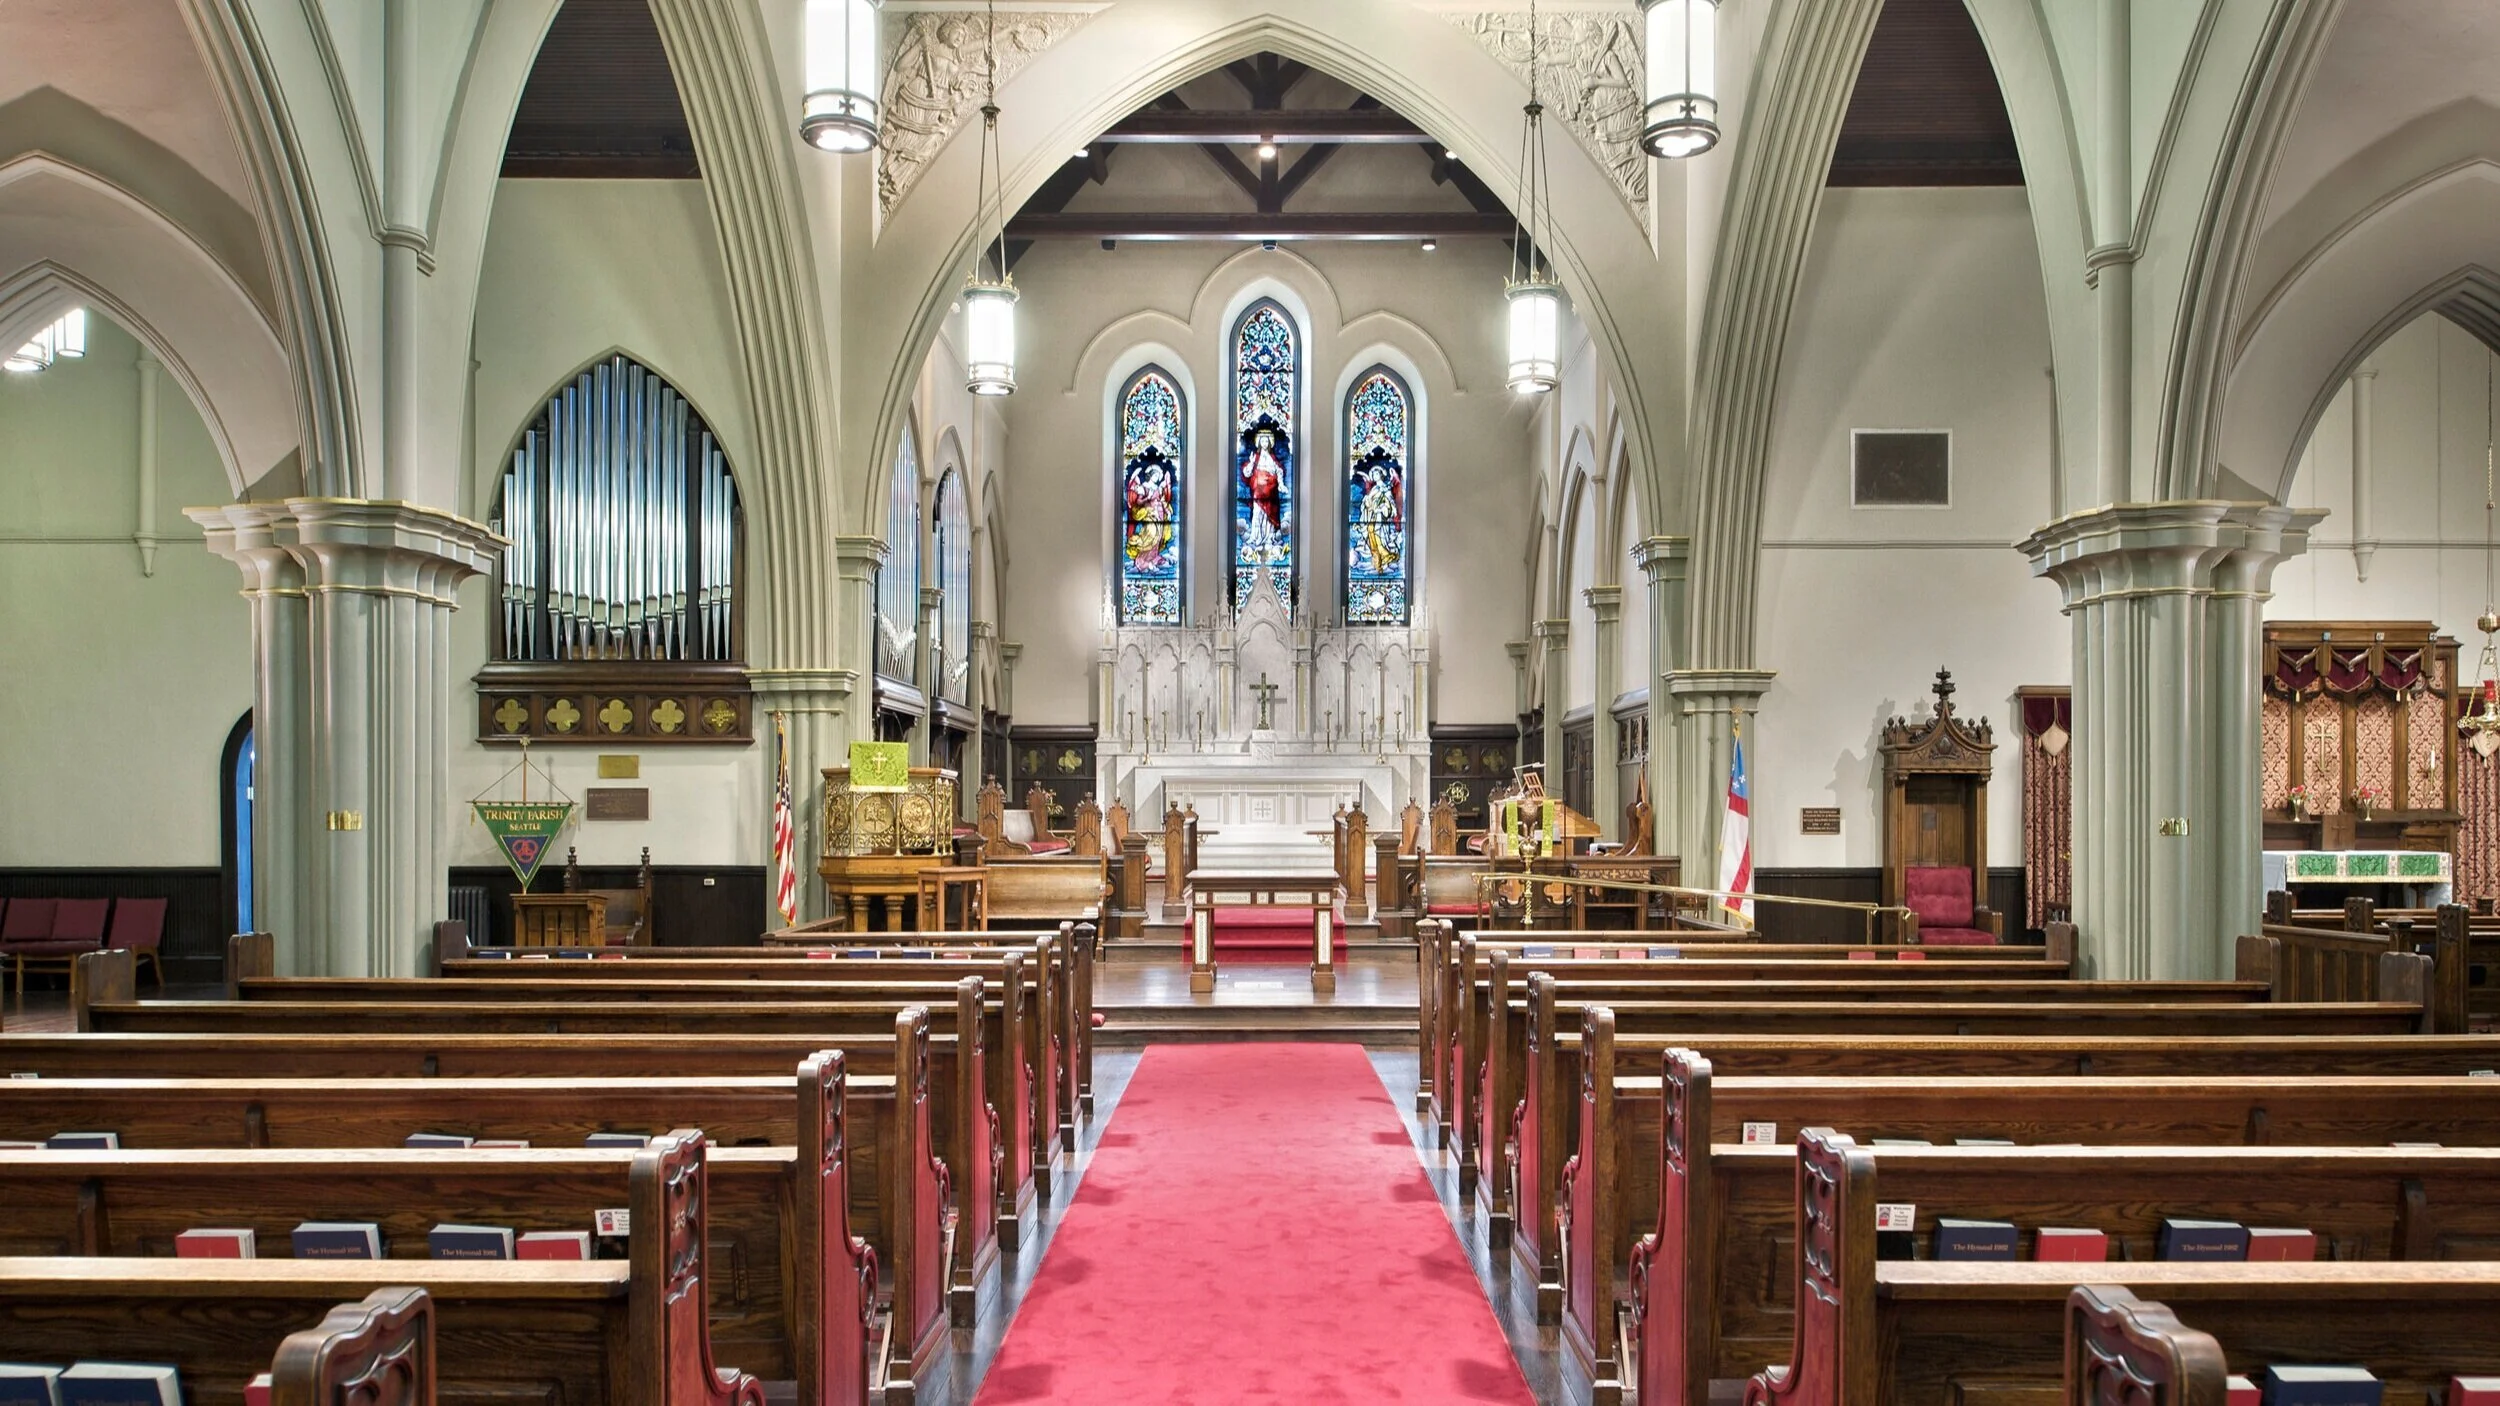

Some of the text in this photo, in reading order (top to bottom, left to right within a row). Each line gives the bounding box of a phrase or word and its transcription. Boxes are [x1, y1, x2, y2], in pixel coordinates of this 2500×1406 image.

[484, 809, 564, 820] TRINITY PARISH
[509, 823, 541, 831] SEATTLE
[305, 1247, 319, 1255] The
[1952, 1243, 1966, 1251] The
[1967, 1243, 1993, 1252] Hymnal
[2181, 1244, 2196, 1252] The
[2197, 1244, 2223, 1253] Hymnal
[456, 1249, 482, 1257] Hymnal
